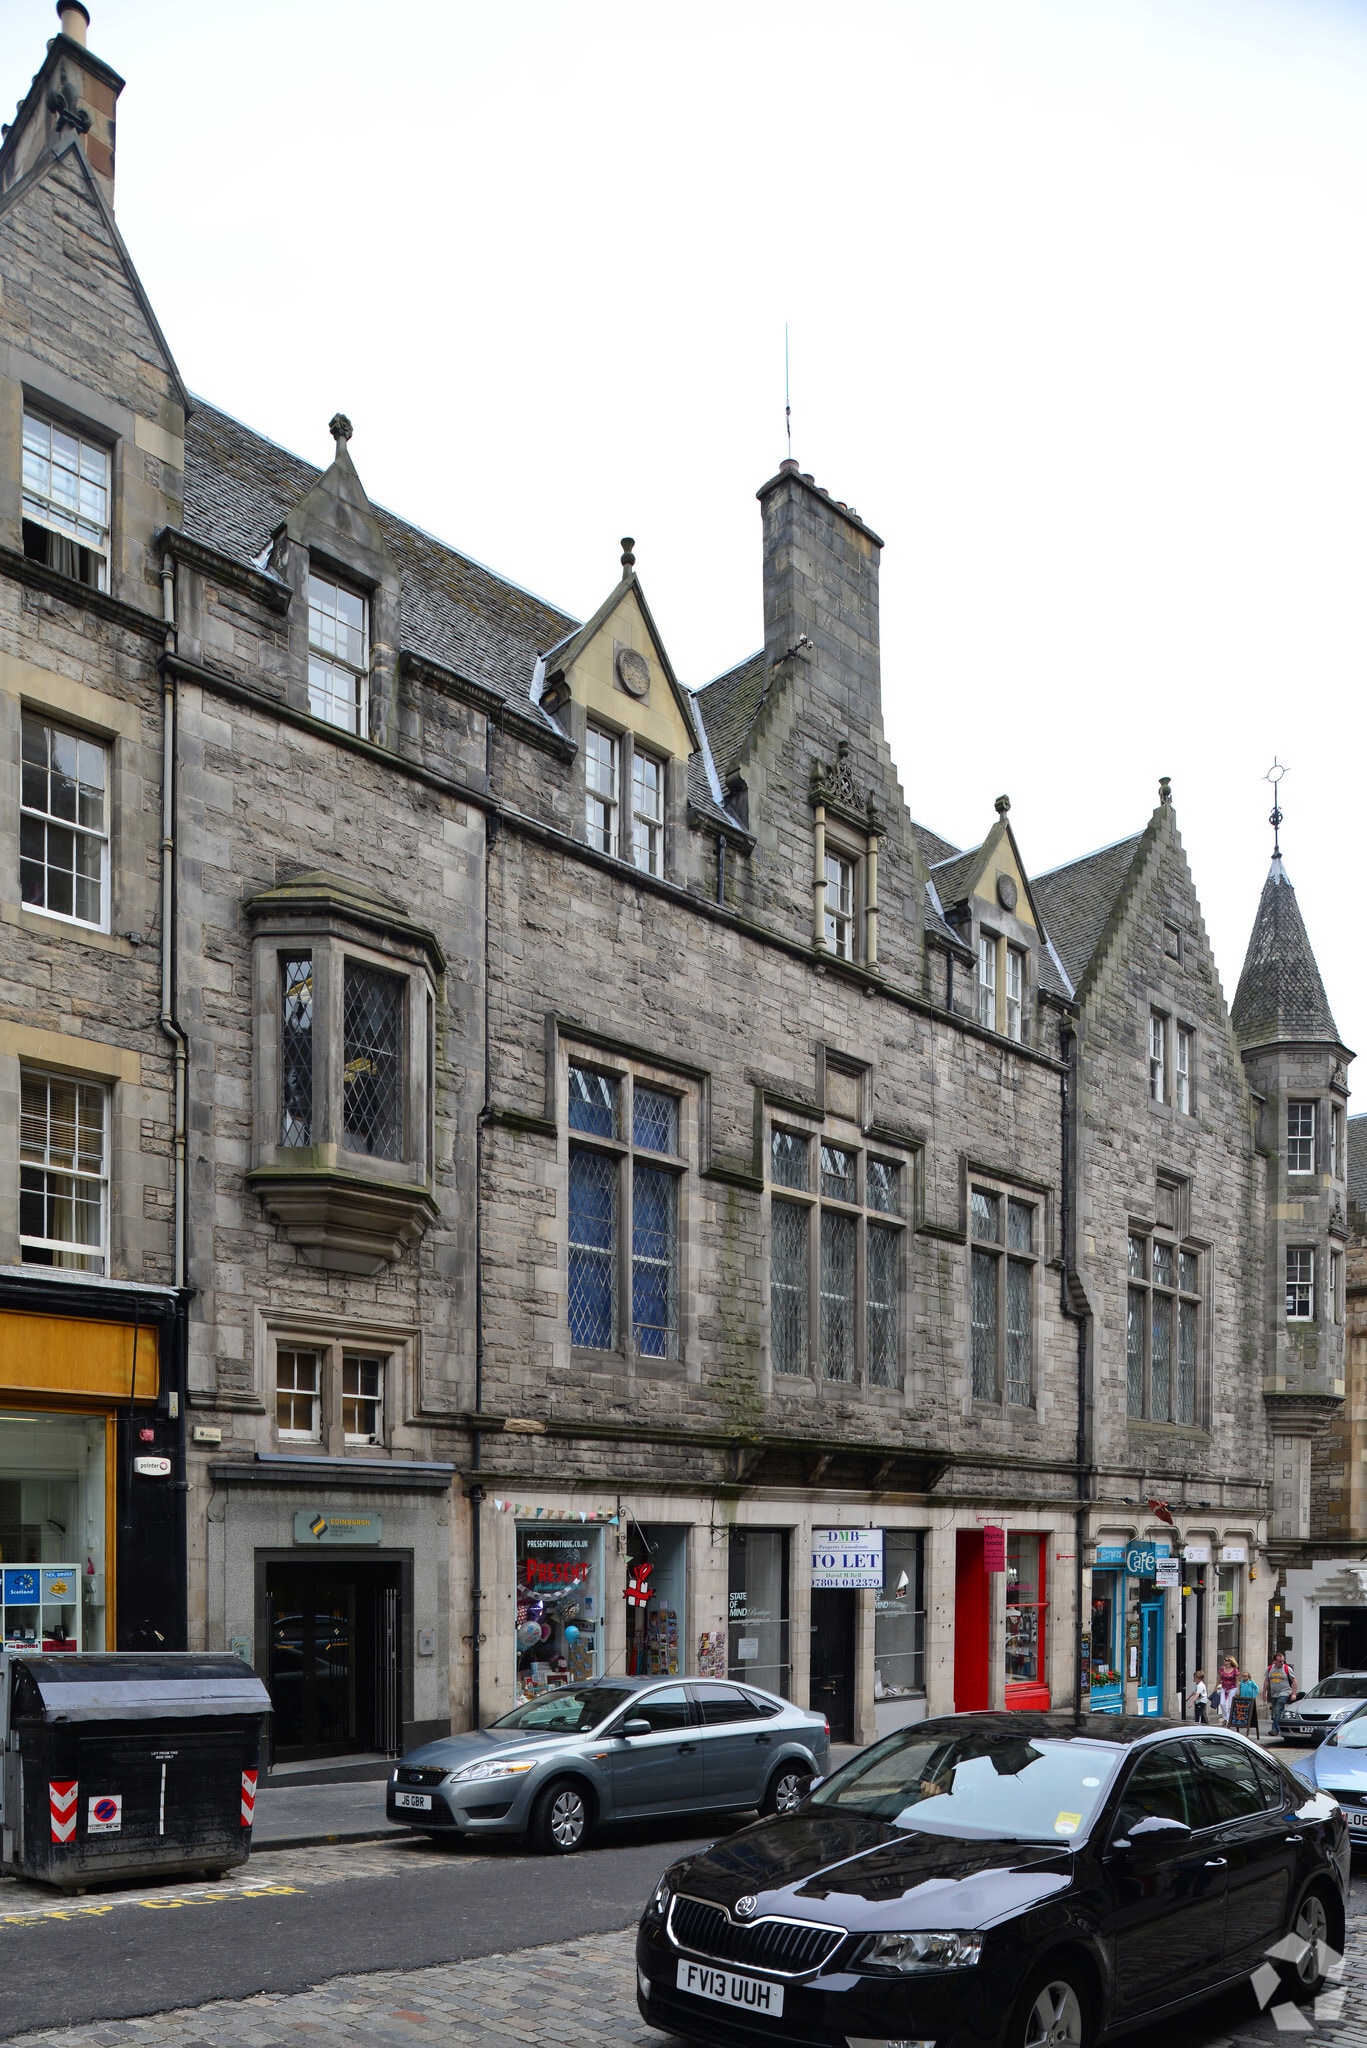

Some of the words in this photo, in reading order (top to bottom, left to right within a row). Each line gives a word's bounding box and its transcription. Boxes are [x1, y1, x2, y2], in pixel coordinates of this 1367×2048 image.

[828, 1531, 859, 1541] DMB
[811, 1554, 835, 1568] TO
[842, 1554, 879, 1568] LET
[527, 1559, 588, 1583] PRESENT
[730, 1592, 747, 1600] STATE
[730, 1608, 747, 1616] MIND
[402, 1795, 409, 1805] J6
[411, 1796, 424, 1807] GBR
[139, 1886, 306, 1909] CLEAR
[687, 1965, 726, 1997] FV13
[731, 1977, 770, 2010] UUH
